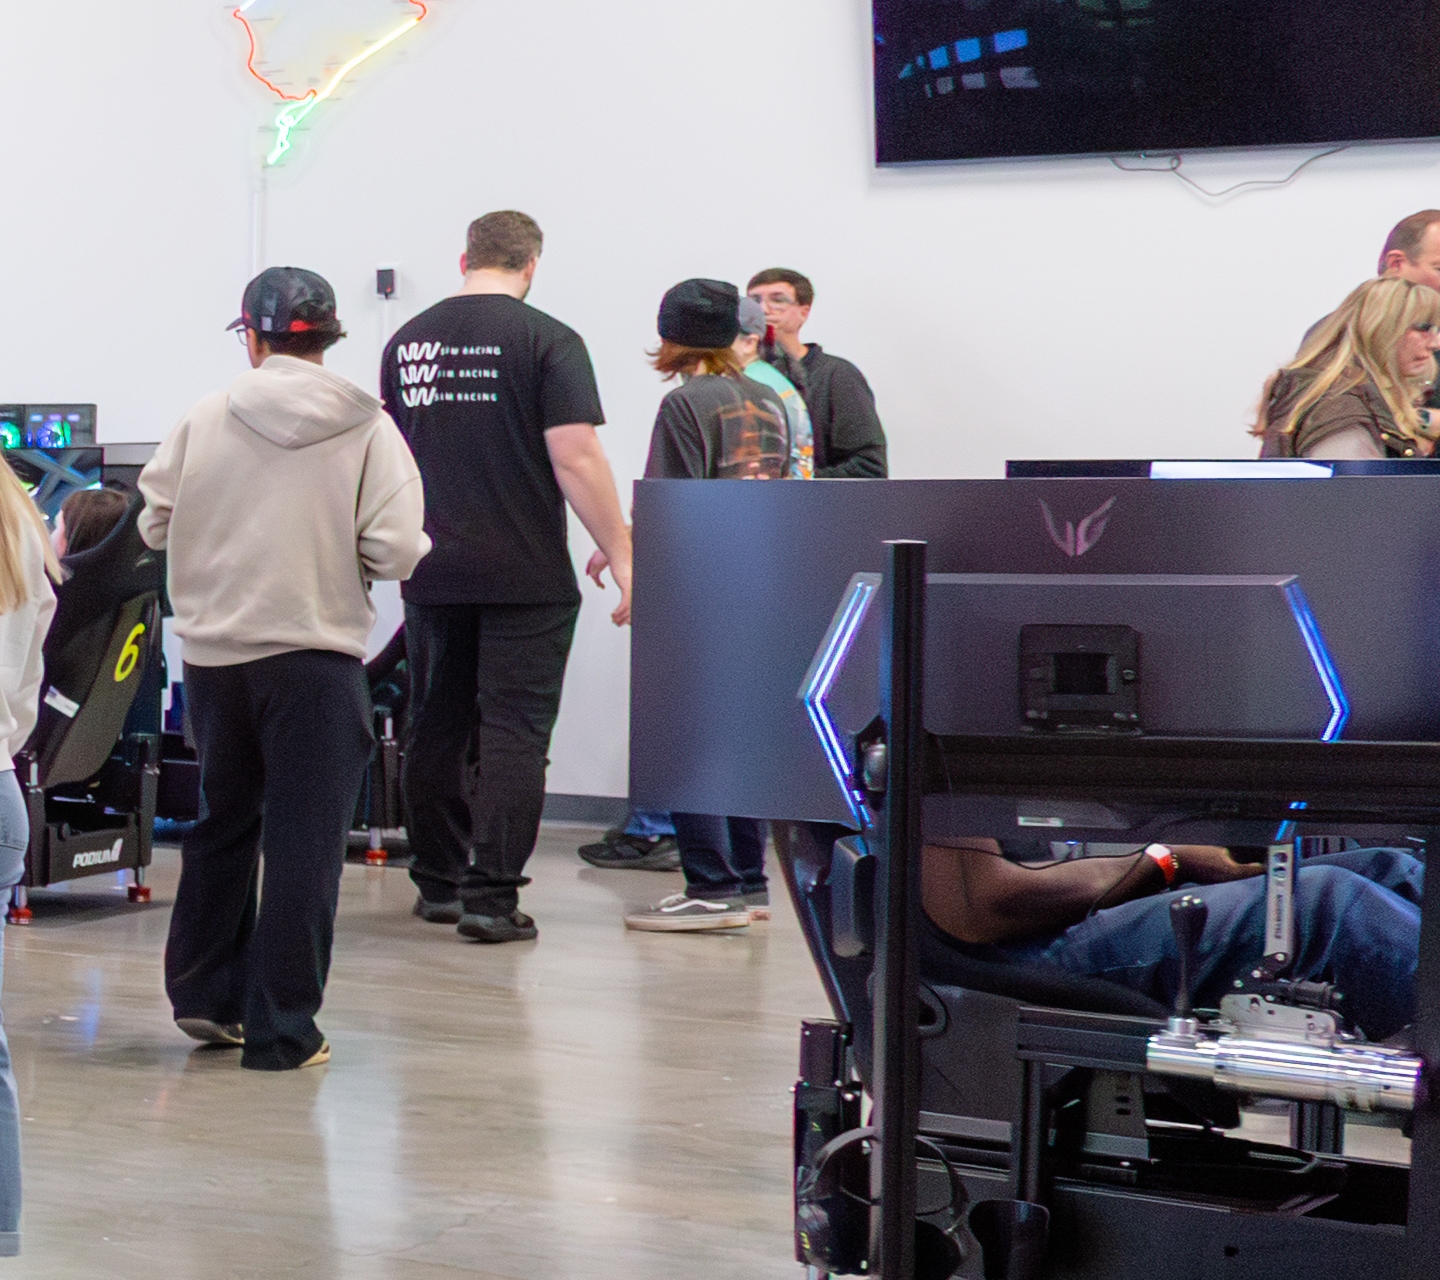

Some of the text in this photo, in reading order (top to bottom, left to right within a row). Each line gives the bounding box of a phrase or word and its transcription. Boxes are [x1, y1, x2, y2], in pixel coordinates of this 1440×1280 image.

[441, 346, 459, 356] SIM
[462, 345, 502, 356] RACING
[437, 369, 455, 379] SIM
[458, 368, 499, 379] RACING
[456, 392, 499, 402] RACING
[114, 622, 146, 683] 6
